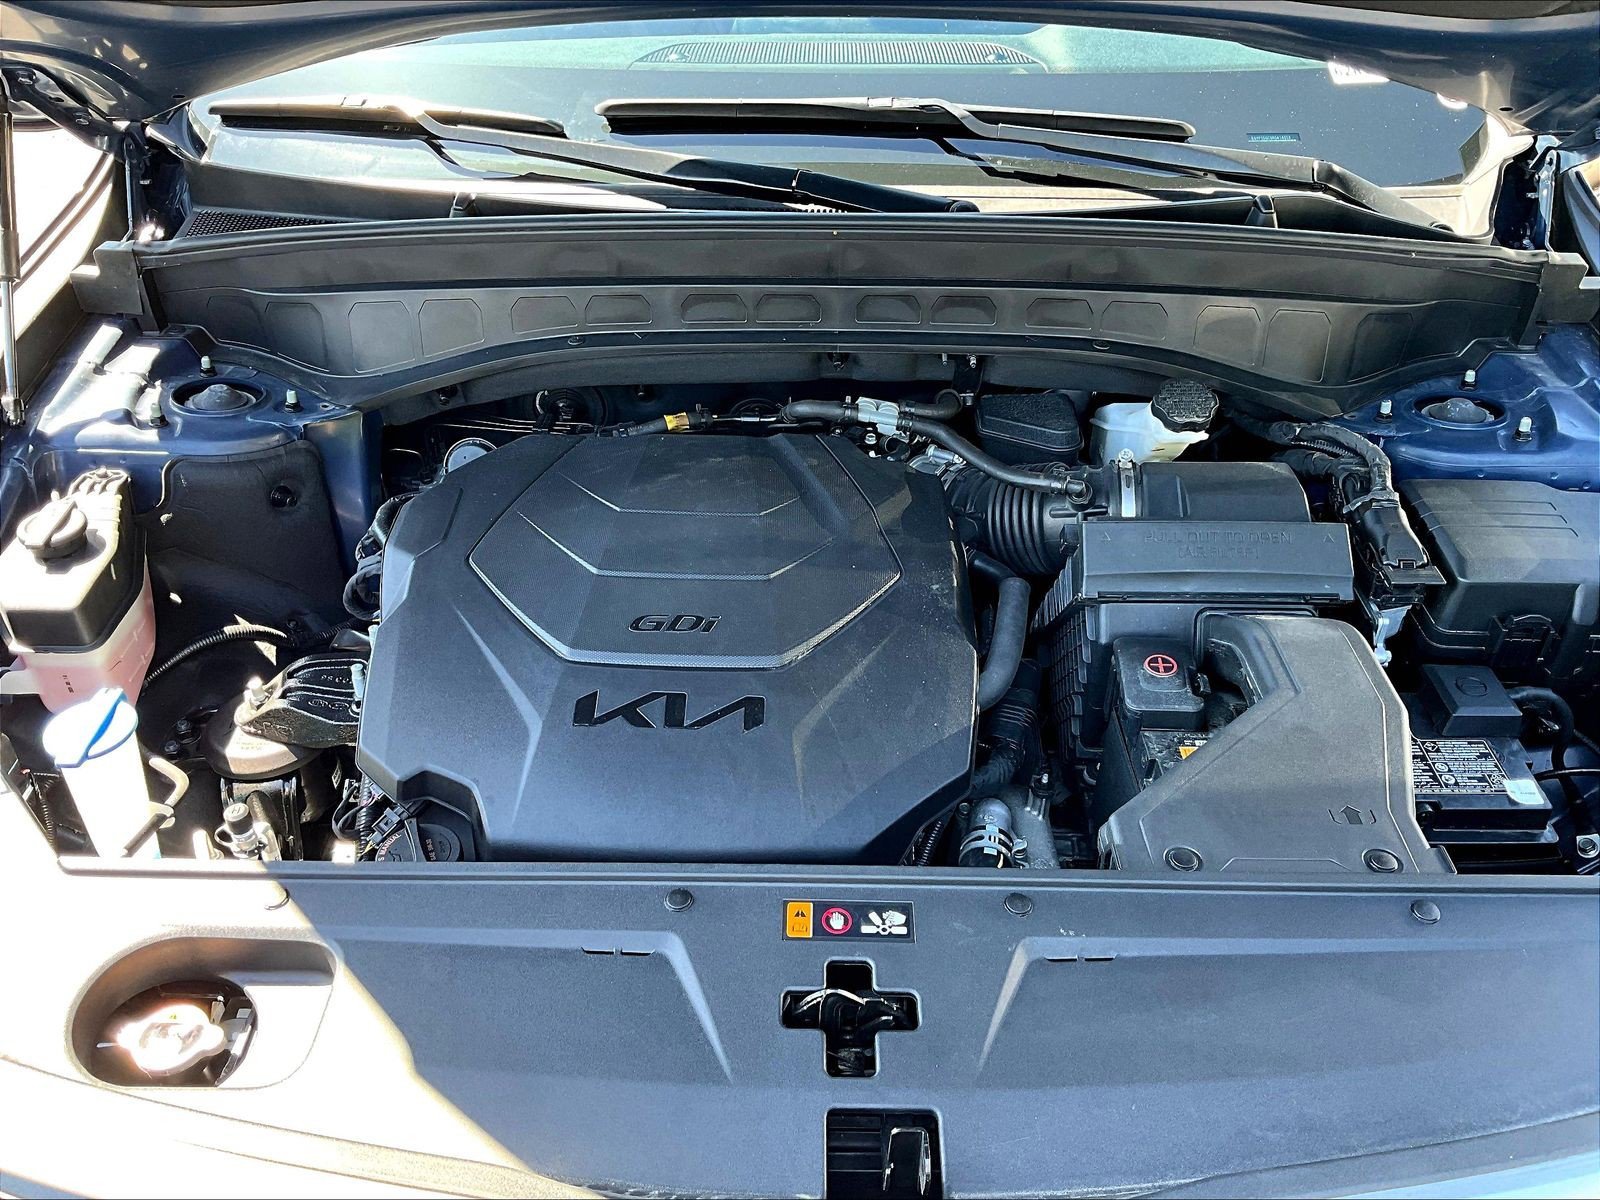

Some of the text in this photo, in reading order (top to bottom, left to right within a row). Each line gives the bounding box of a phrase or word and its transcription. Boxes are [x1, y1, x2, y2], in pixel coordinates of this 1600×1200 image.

[1144, 530, 1293, 545] PULL OUT TO OPEN
[628, 614, 722, 634] GDi
[572, 689, 767, 734] KIA
[379, 833, 401, 855] MANUAL
